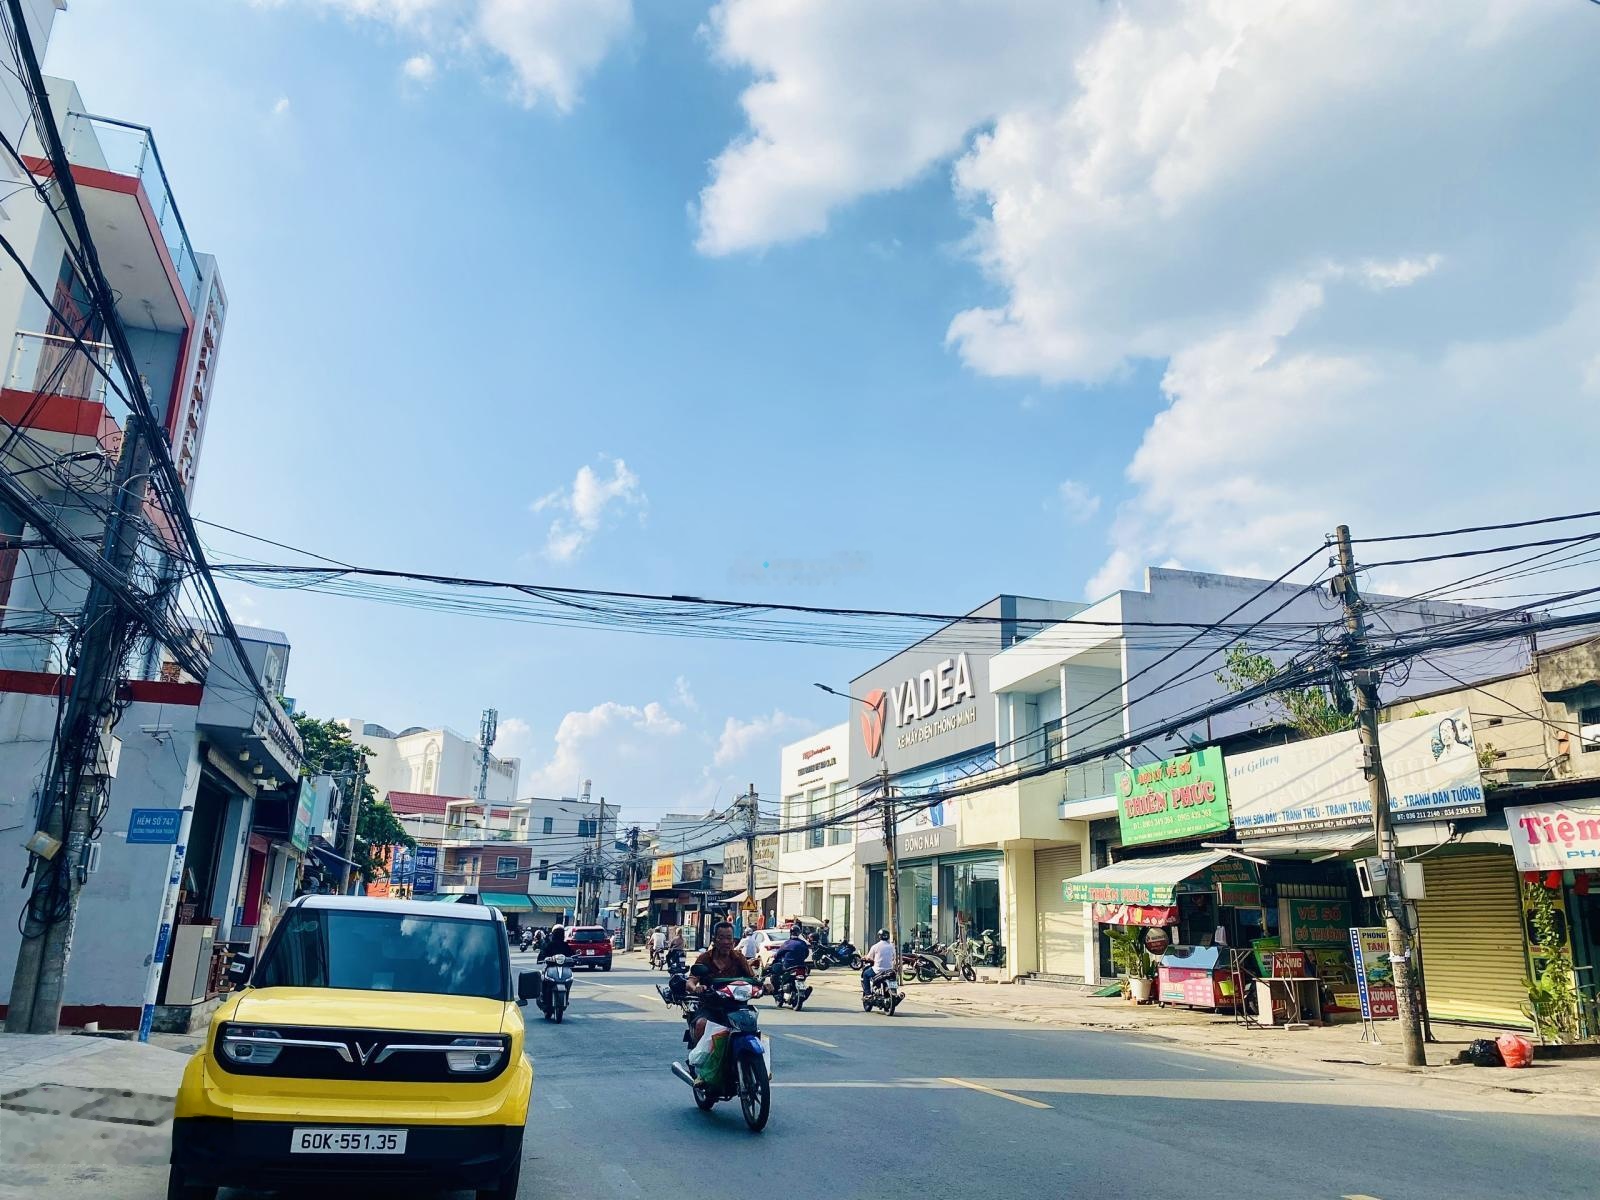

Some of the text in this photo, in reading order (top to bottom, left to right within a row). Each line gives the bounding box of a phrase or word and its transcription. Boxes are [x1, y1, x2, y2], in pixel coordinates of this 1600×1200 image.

[891, 652, 976, 728] YADEA
[897, 734, 906, 749] XE
[906, 727, 918, 746] MÁY
[933, 714, 957, 736] THÔNG
[957, 706, 977, 729] MINH
[1166, 760, 1178, 779] VÉ
[1179, 755, 1192, 776] SỐ
[1124, 776, 1216, 819] THIÊN PHÚC
[1234, 815, 1254, 829] TRANH
[1282, 809, 1303, 822] TRANH
[1326, 803, 1348, 816] TRANH
[1404, 792, 1431, 808] TRANH
[1432, 788, 1450, 805] DÁN
[1451, 784, 1481, 803] TƯỜNG
[1470, 806, 1482, 814] 573
[924, 833, 941, 848] NAM
[301, 1133, 398, 1150] 60K-551.35
